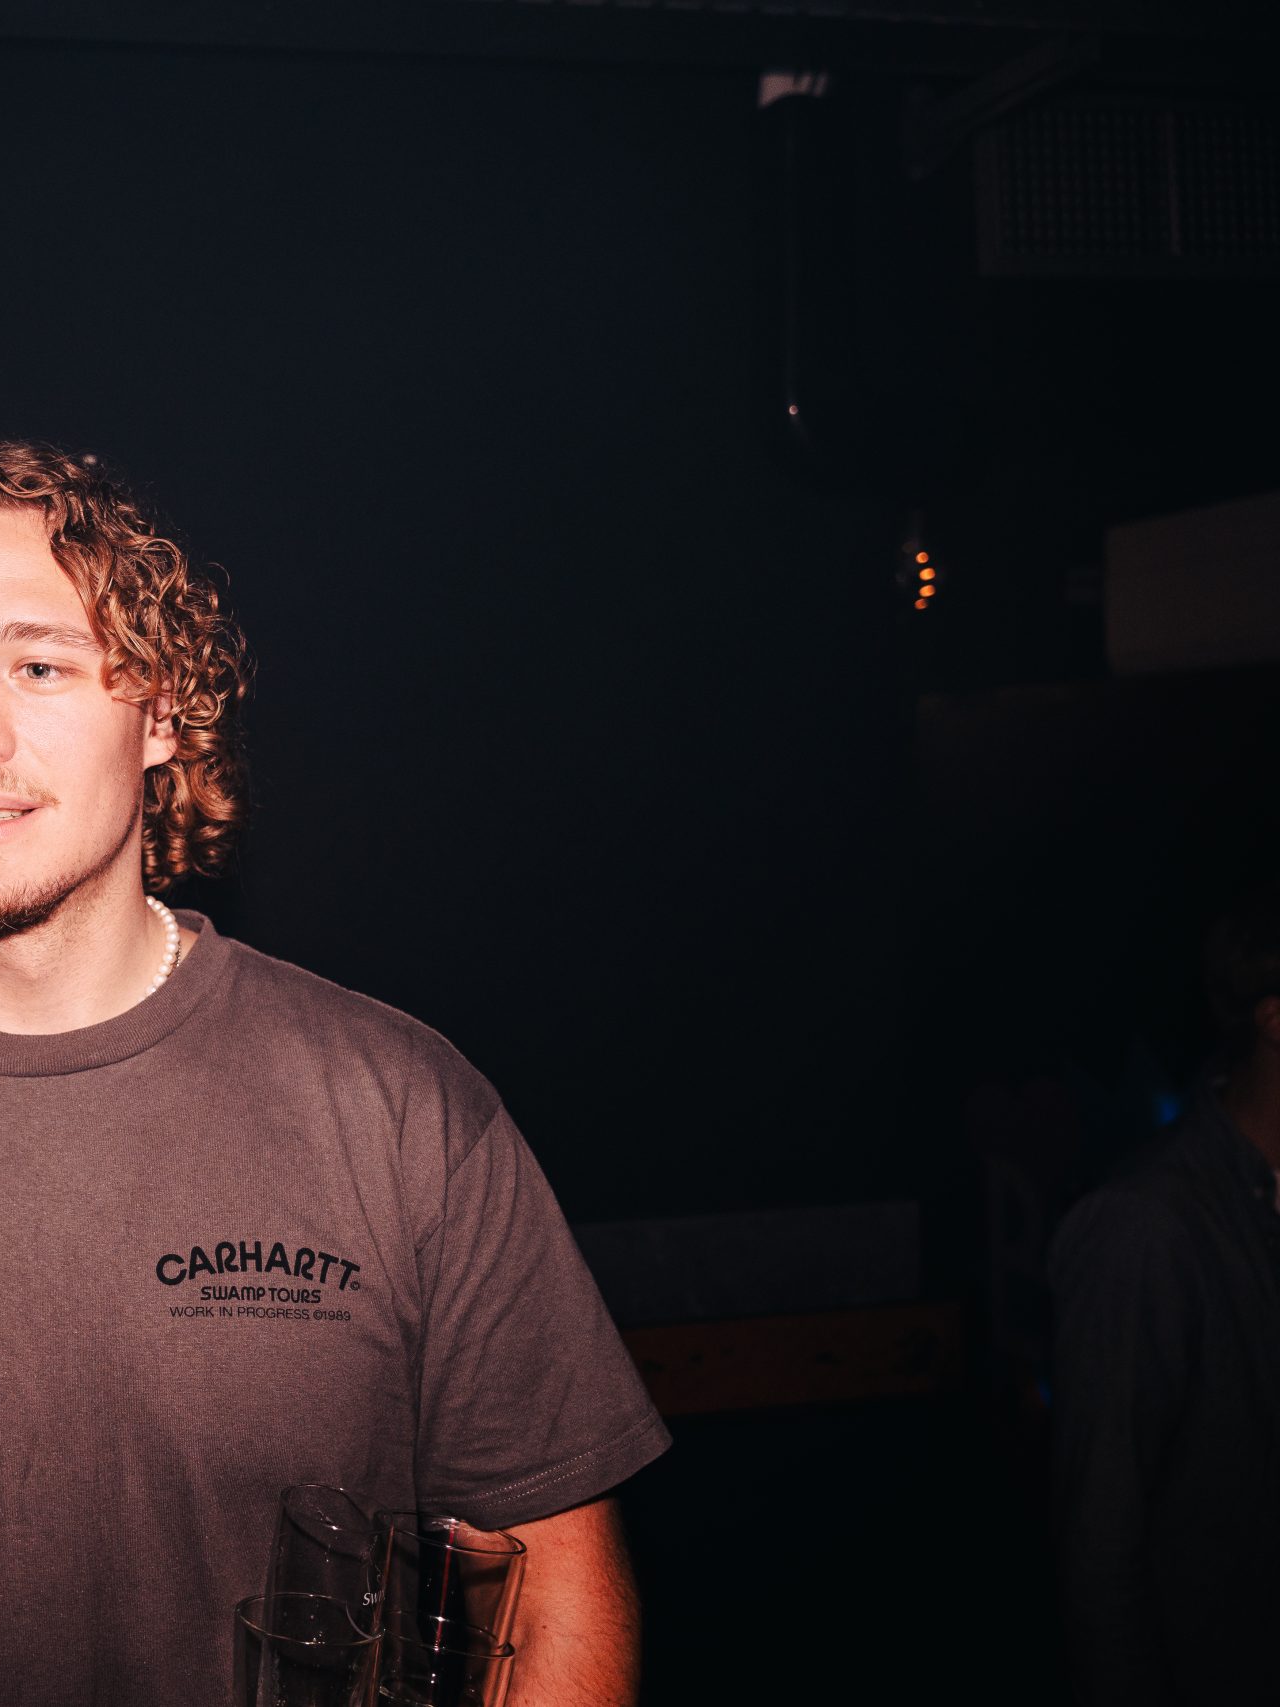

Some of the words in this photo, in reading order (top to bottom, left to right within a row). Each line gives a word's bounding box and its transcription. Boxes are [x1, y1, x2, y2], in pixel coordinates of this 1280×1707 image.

[200, 1285, 266, 1301] SWAMP
[268, 1287, 322, 1304] TOURS
[169, 1306, 214, 1318] WORK
[219, 1306, 233, 1317] IN
[237, 1306, 310, 1320] PROGRESS
